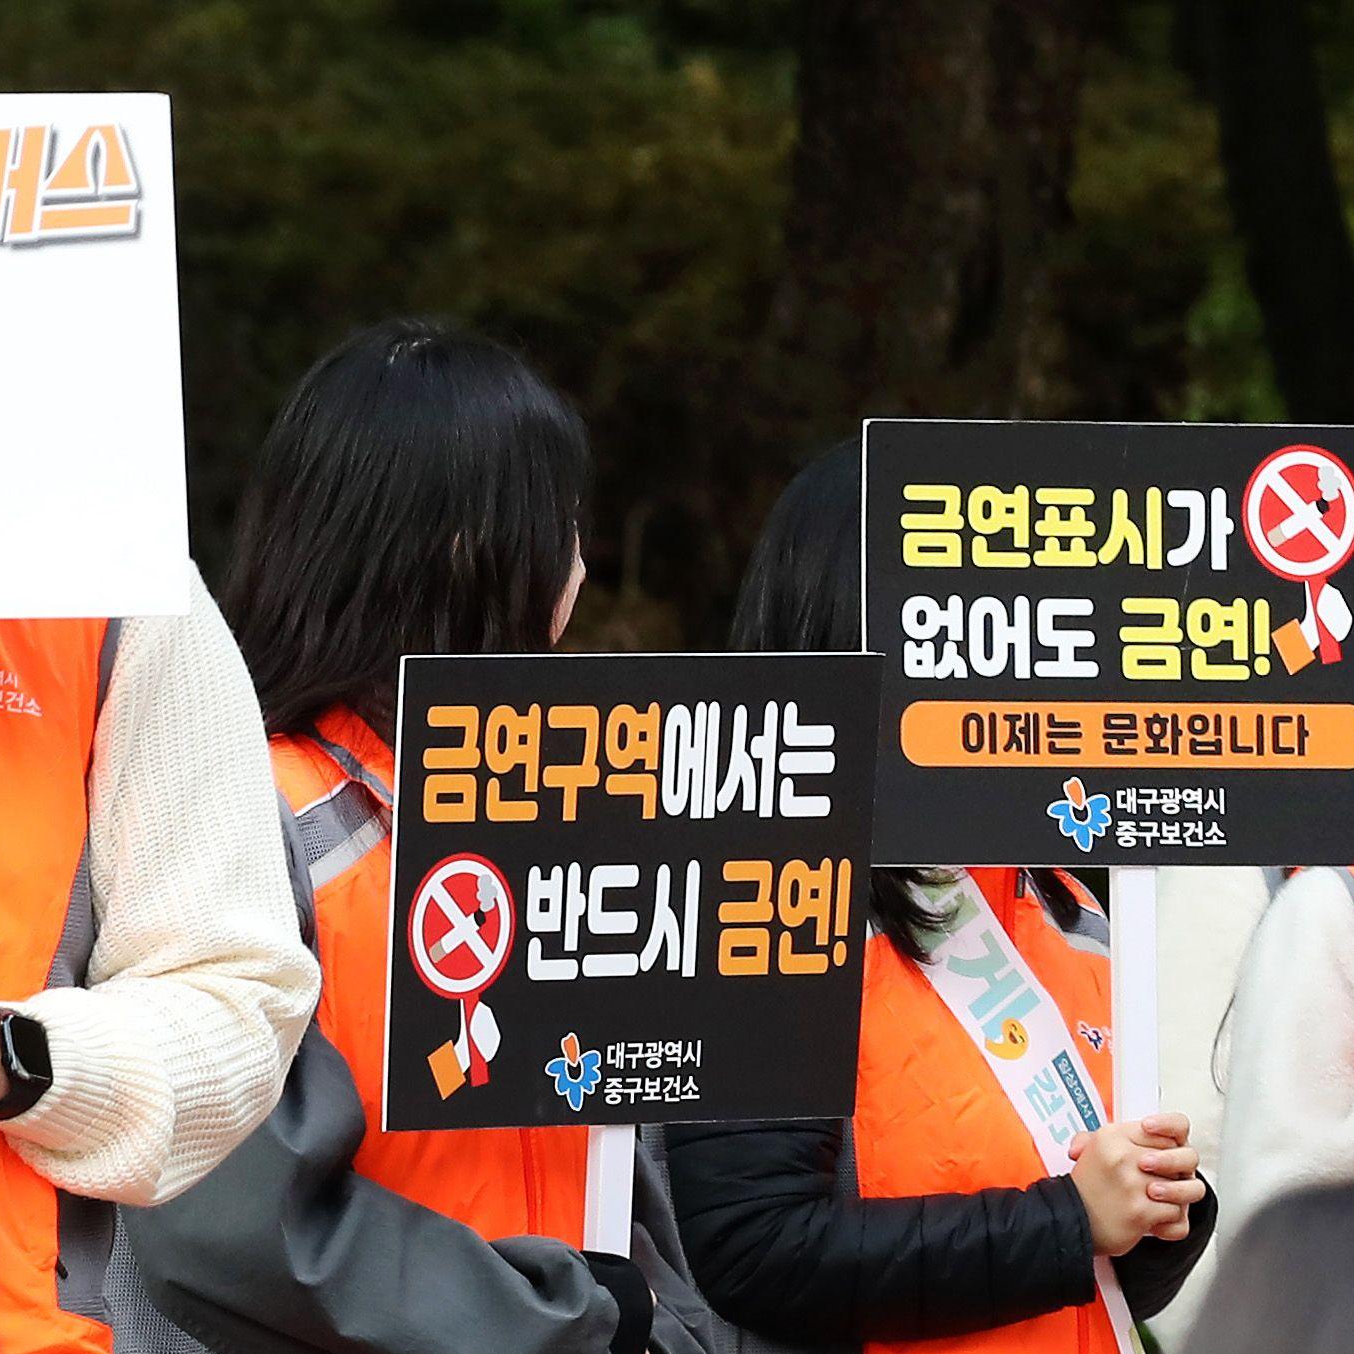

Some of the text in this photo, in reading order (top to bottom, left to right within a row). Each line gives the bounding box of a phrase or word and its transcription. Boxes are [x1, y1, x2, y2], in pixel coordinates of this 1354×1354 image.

[899, 483, 1235, 572] 금연표시가
[900, 593, 1272, 682] 없어도 금연!
[959, 710, 1311, 758] 이제는 문화입니다
[421, 698, 837, 824] 금연구역에서는
[1115, 786, 1227, 817] 대구광역시
[1114, 820, 1228, 848] 중구보건소
[525, 856, 853, 982] 반드시 금연!
[606, 1038, 704, 1070] 대구광역시
[603, 1075, 701, 1105] 중구보건소
